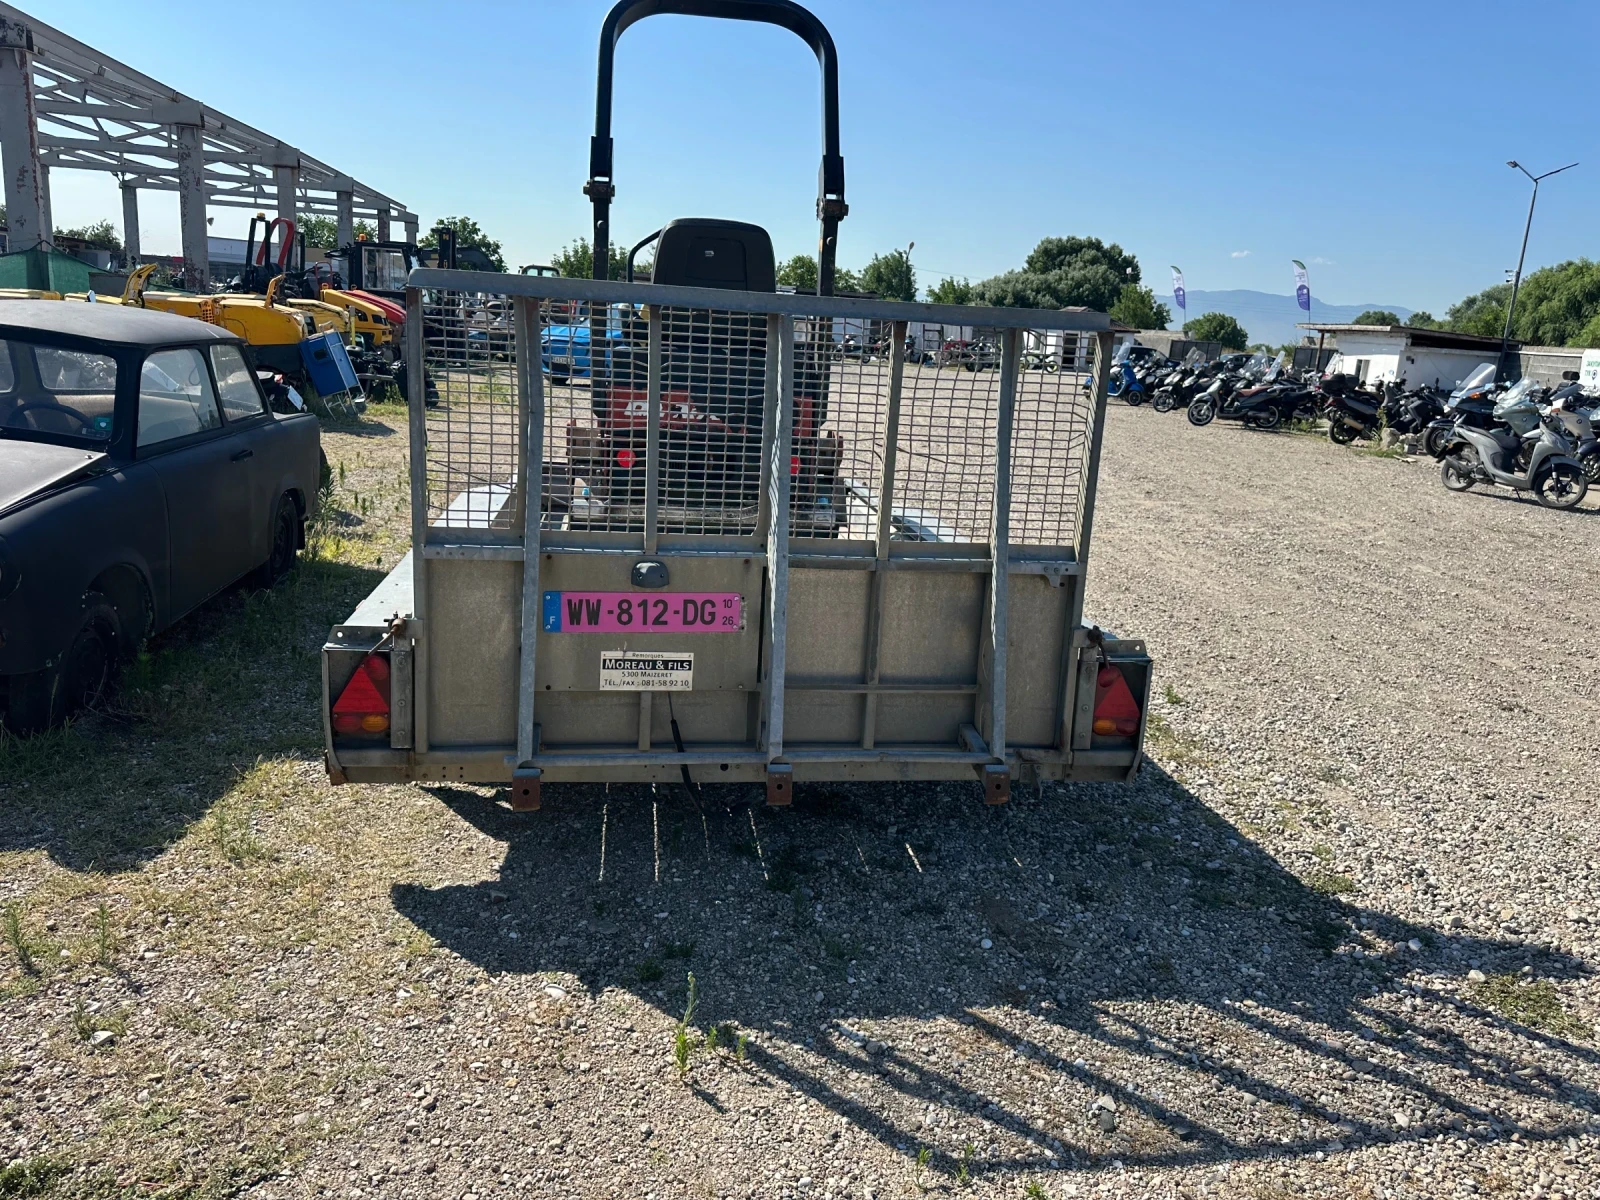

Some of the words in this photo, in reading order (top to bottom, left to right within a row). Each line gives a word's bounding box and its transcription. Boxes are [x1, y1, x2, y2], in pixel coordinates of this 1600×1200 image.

[722, 599, 733, 609] 10
[567, 598, 717, 626] WW-812-DG
[549, 616, 556, 624] F
[722, 616, 734, 626] 26
[632, 652, 664, 660] Remorques
[604, 659, 652, 670] MOREAU
[655, 660, 665, 670] &
[668, 662, 690, 671] FILS
[641, 679, 668, 687] 081-58
[669, 679, 678, 687] 92
[680, 679, 689, 687] 10
